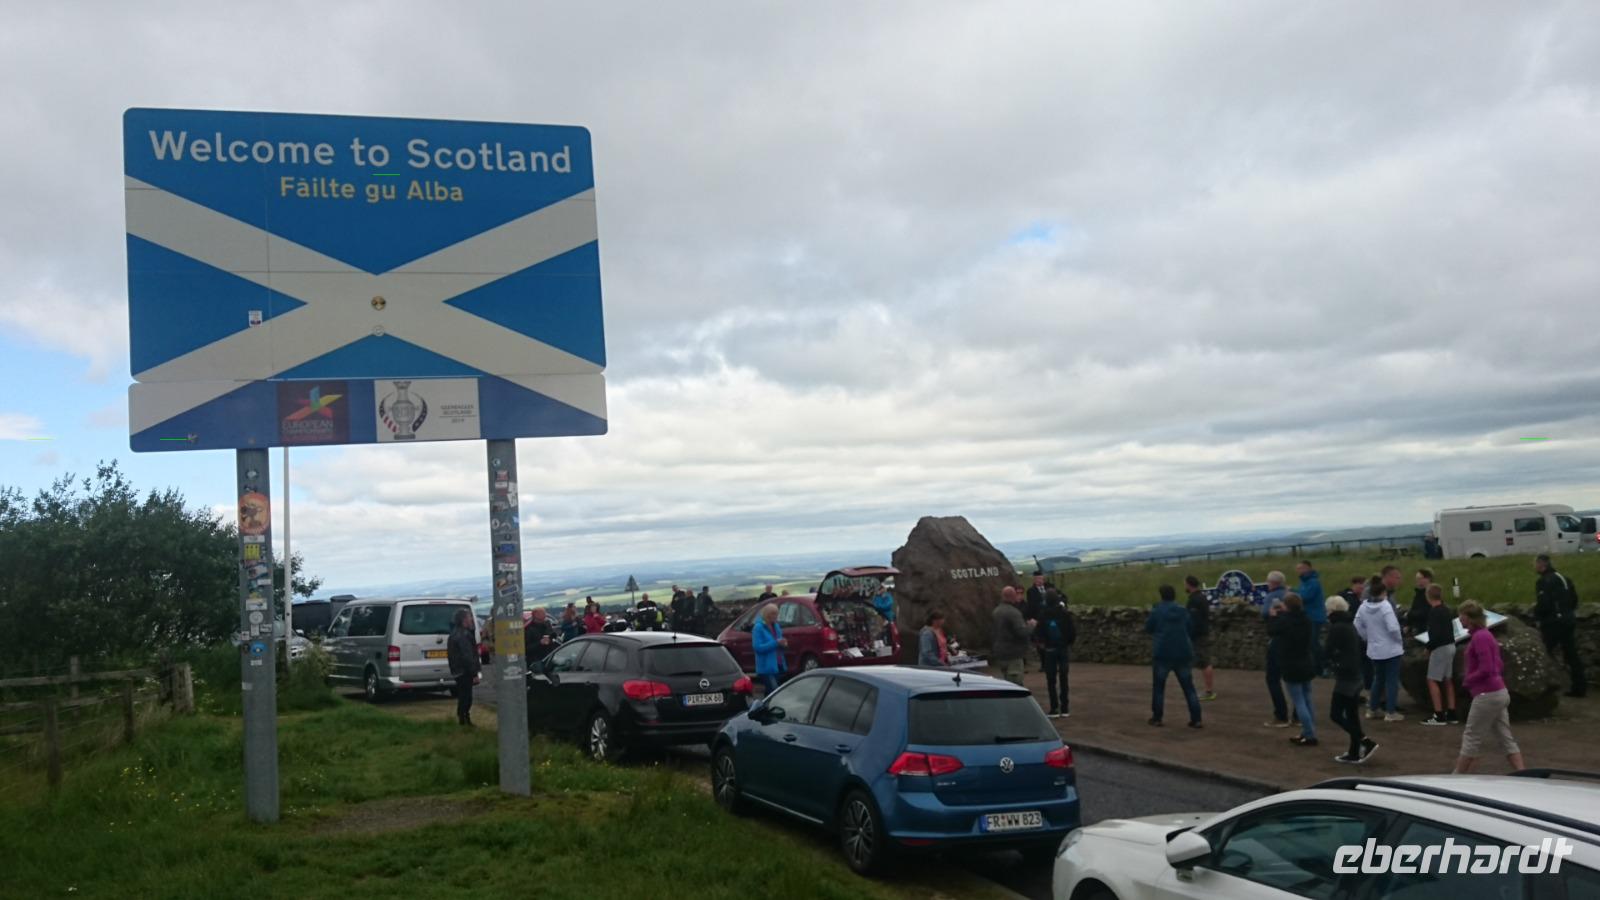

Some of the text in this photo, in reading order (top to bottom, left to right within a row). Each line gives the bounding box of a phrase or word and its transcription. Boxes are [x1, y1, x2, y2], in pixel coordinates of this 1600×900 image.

[148, 129, 572, 174] Welcome to Scotland
[365, 182, 396, 204] gu
[406, 180, 464, 202] Alba
[950, 566, 999, 579] SCOTLAND
[986, 812, 1041, 828] FR WW 823
